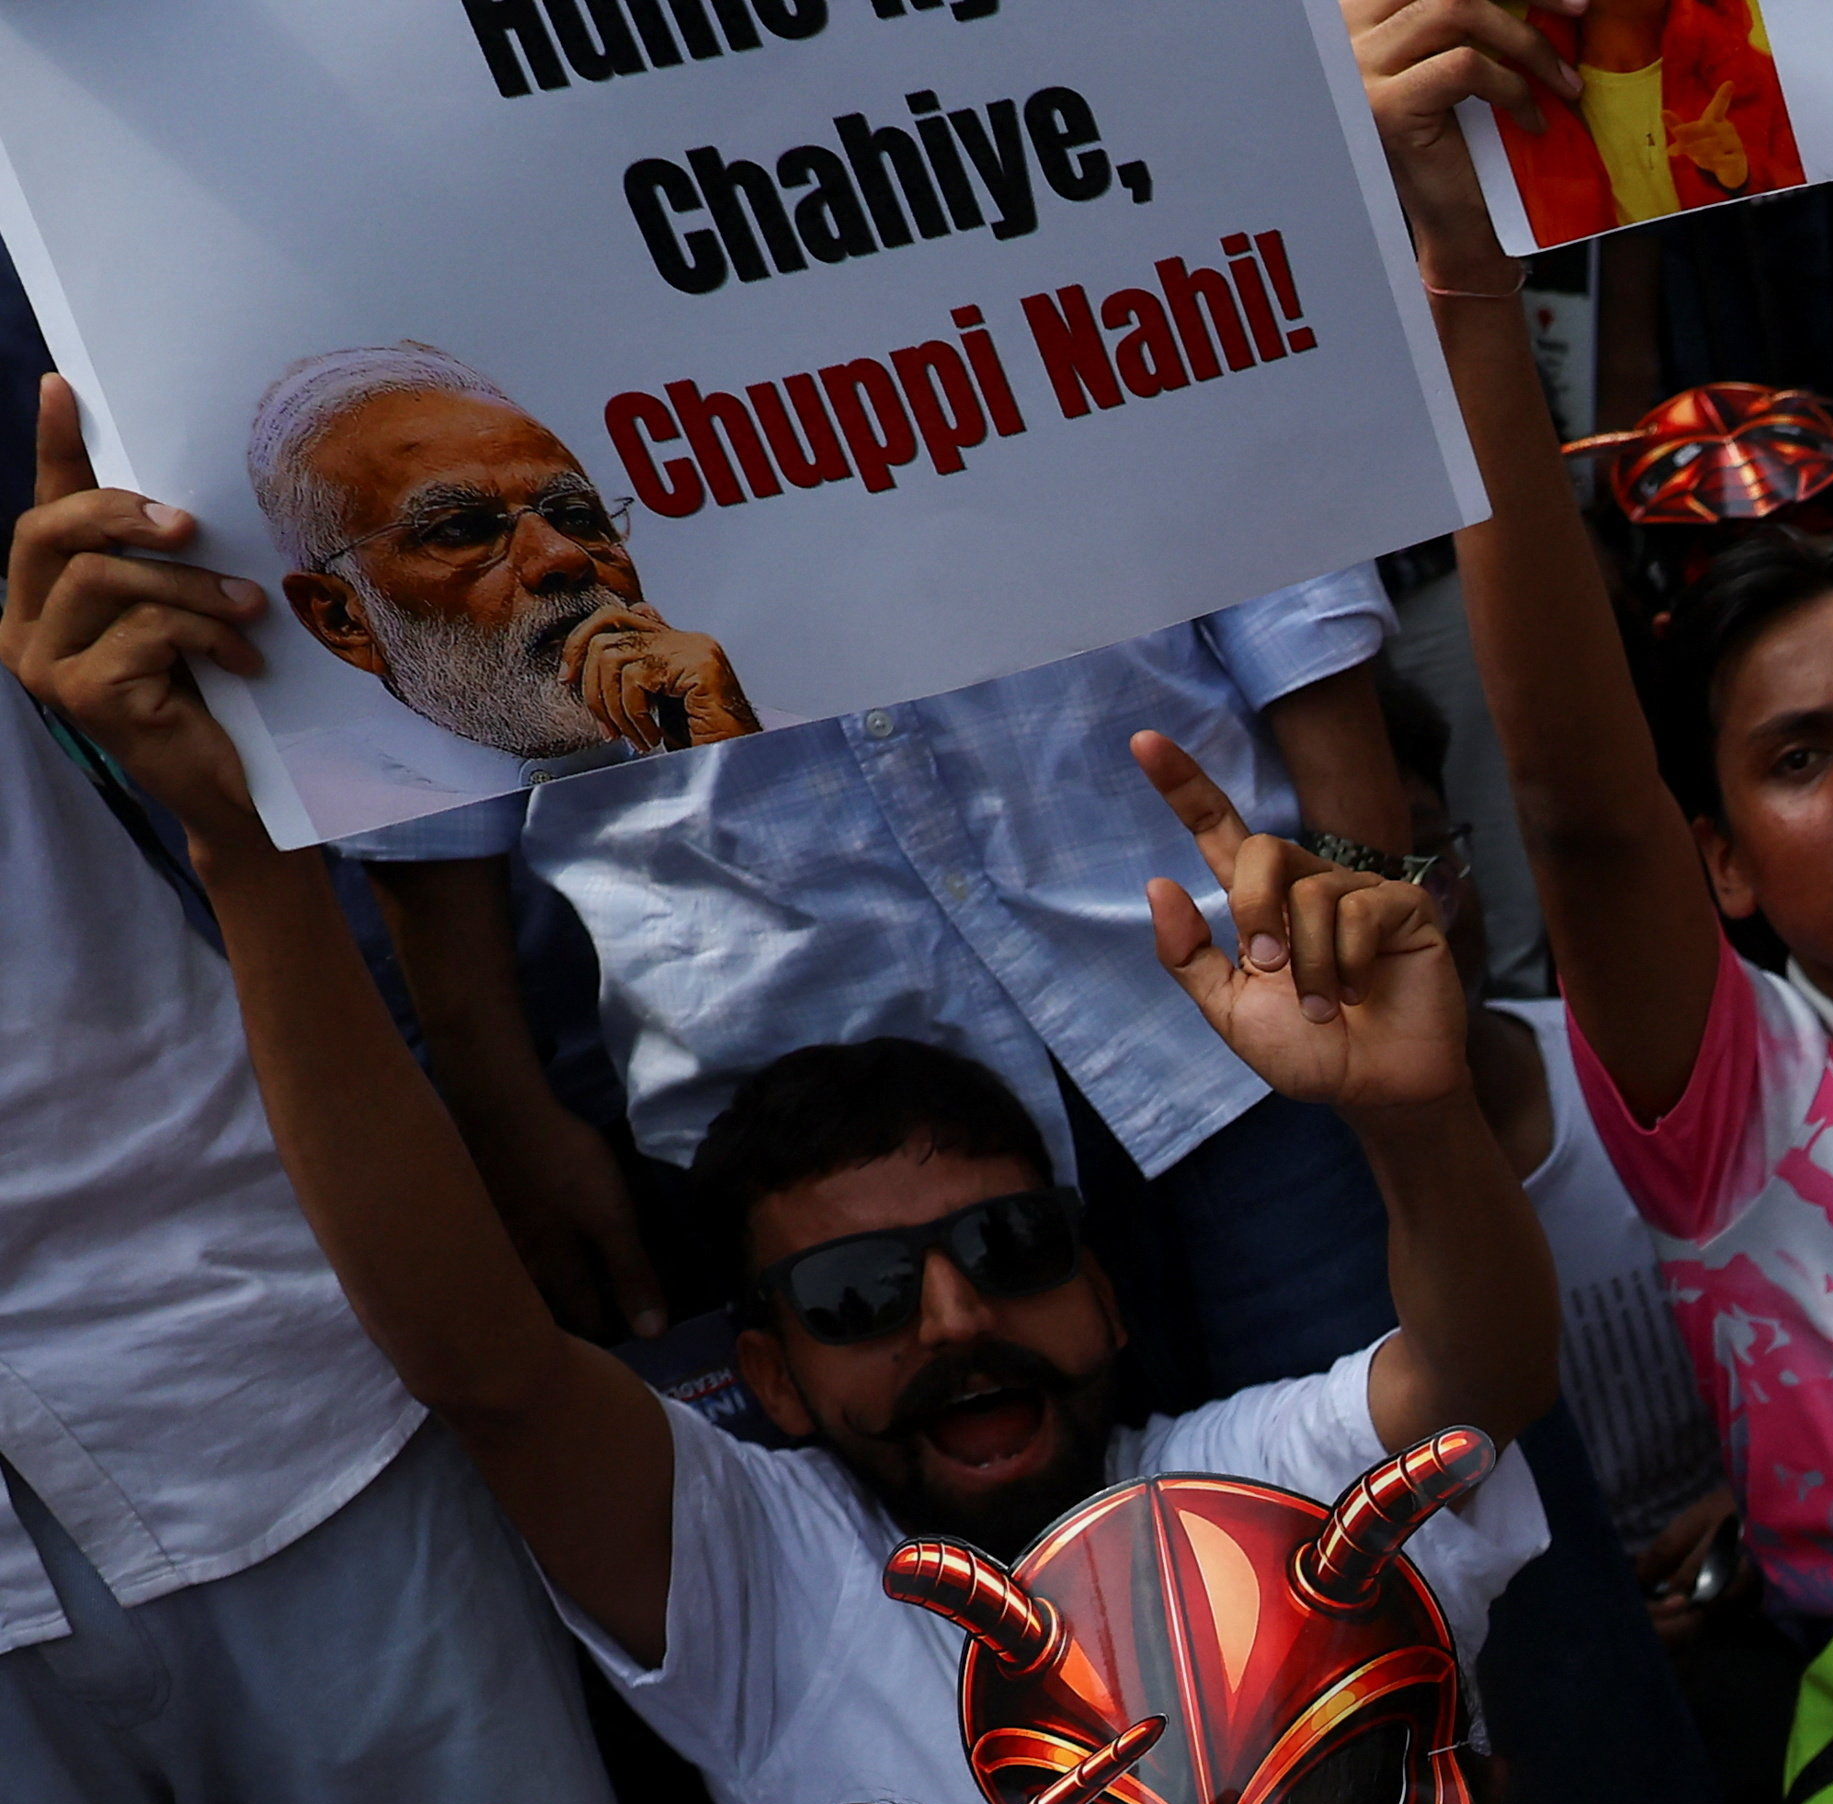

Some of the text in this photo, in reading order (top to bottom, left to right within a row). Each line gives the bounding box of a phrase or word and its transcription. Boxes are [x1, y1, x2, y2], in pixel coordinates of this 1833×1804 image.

[622, 85, 1152, 296] Chahiye,
[603, 229, 1318, 518] Chuppi Nahi!
